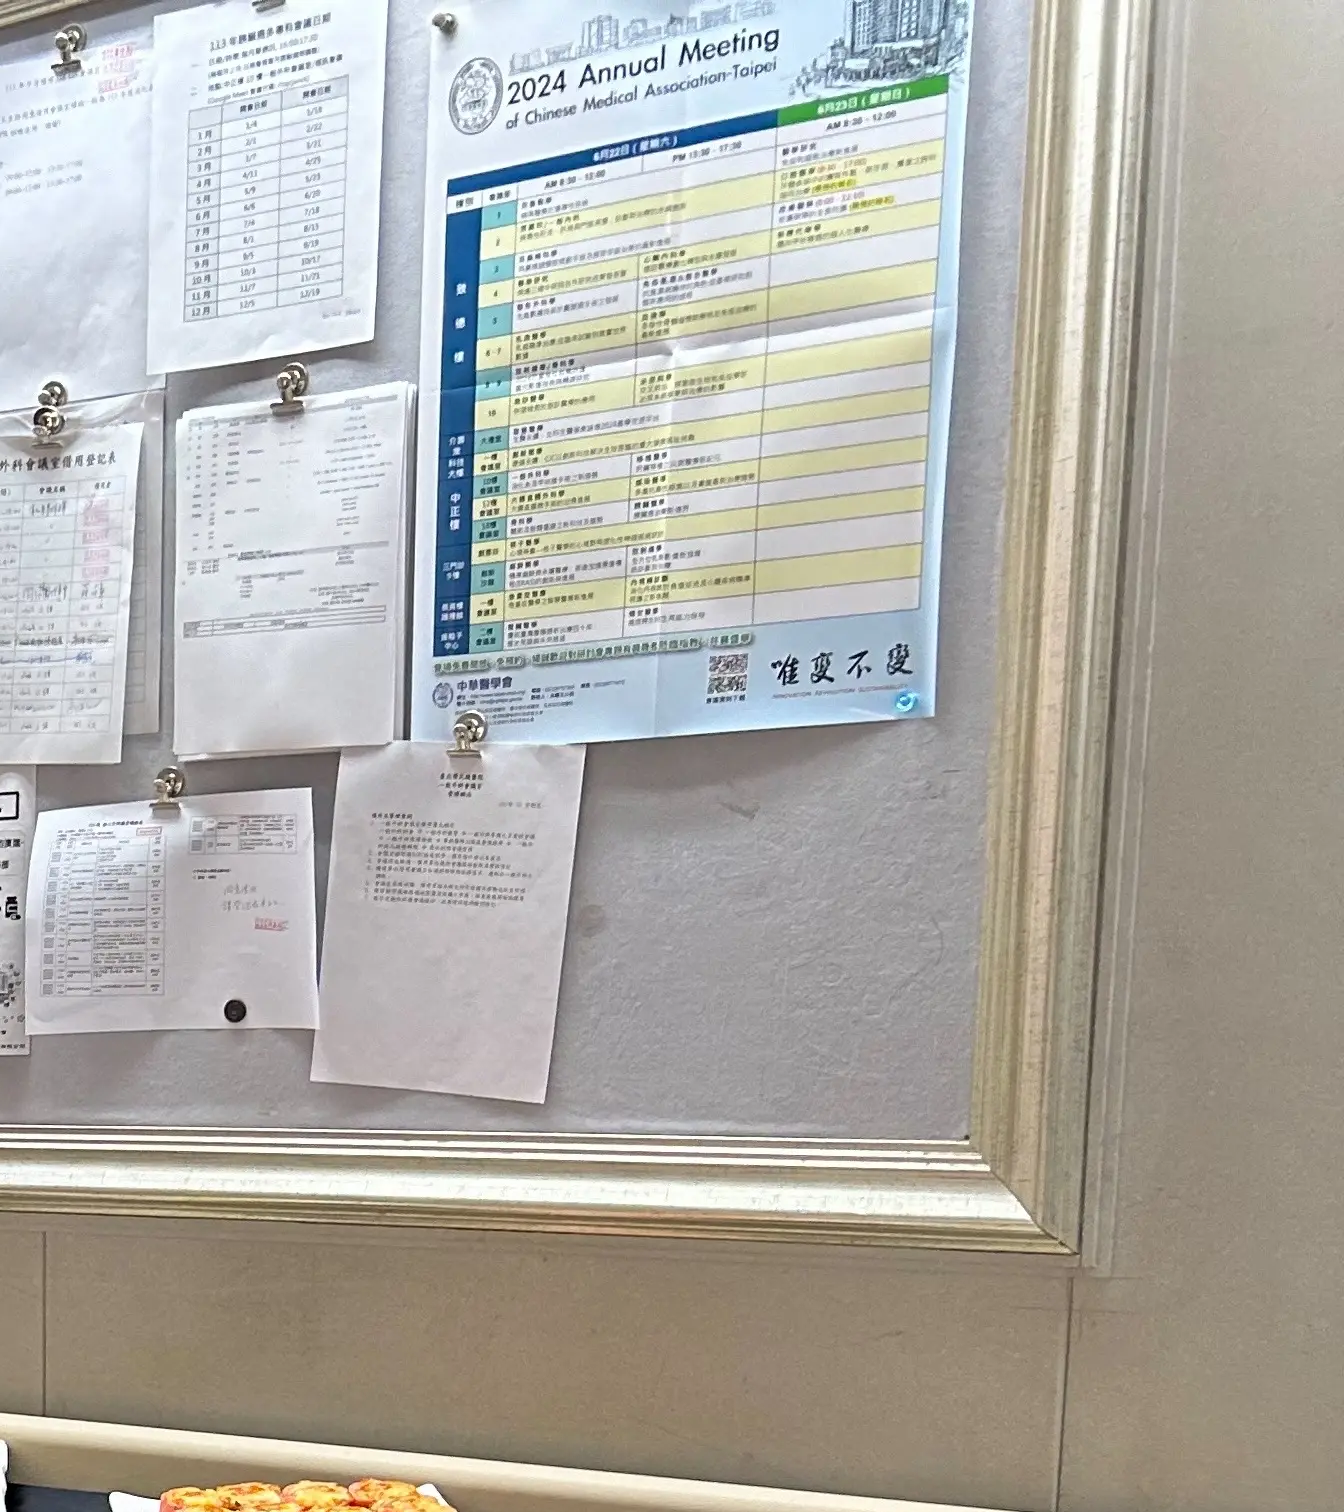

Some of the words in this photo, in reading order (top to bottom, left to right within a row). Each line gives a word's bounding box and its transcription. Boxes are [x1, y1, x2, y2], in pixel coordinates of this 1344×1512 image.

[505, 113, 520, 130] of
[525, 102, 577, 126] Chinese
[583, 86, 638, 113] Medical
[644, 56, 778, 100] Association-Taipei
[507, 69, 566, 106] 2024
[578, 44, 666, 89] Annual
[678, 28, 780, 67] Meeting
[457, 676, 513, 691] 中華醫學會
[771, 643, 913, 686] 唯變不變
